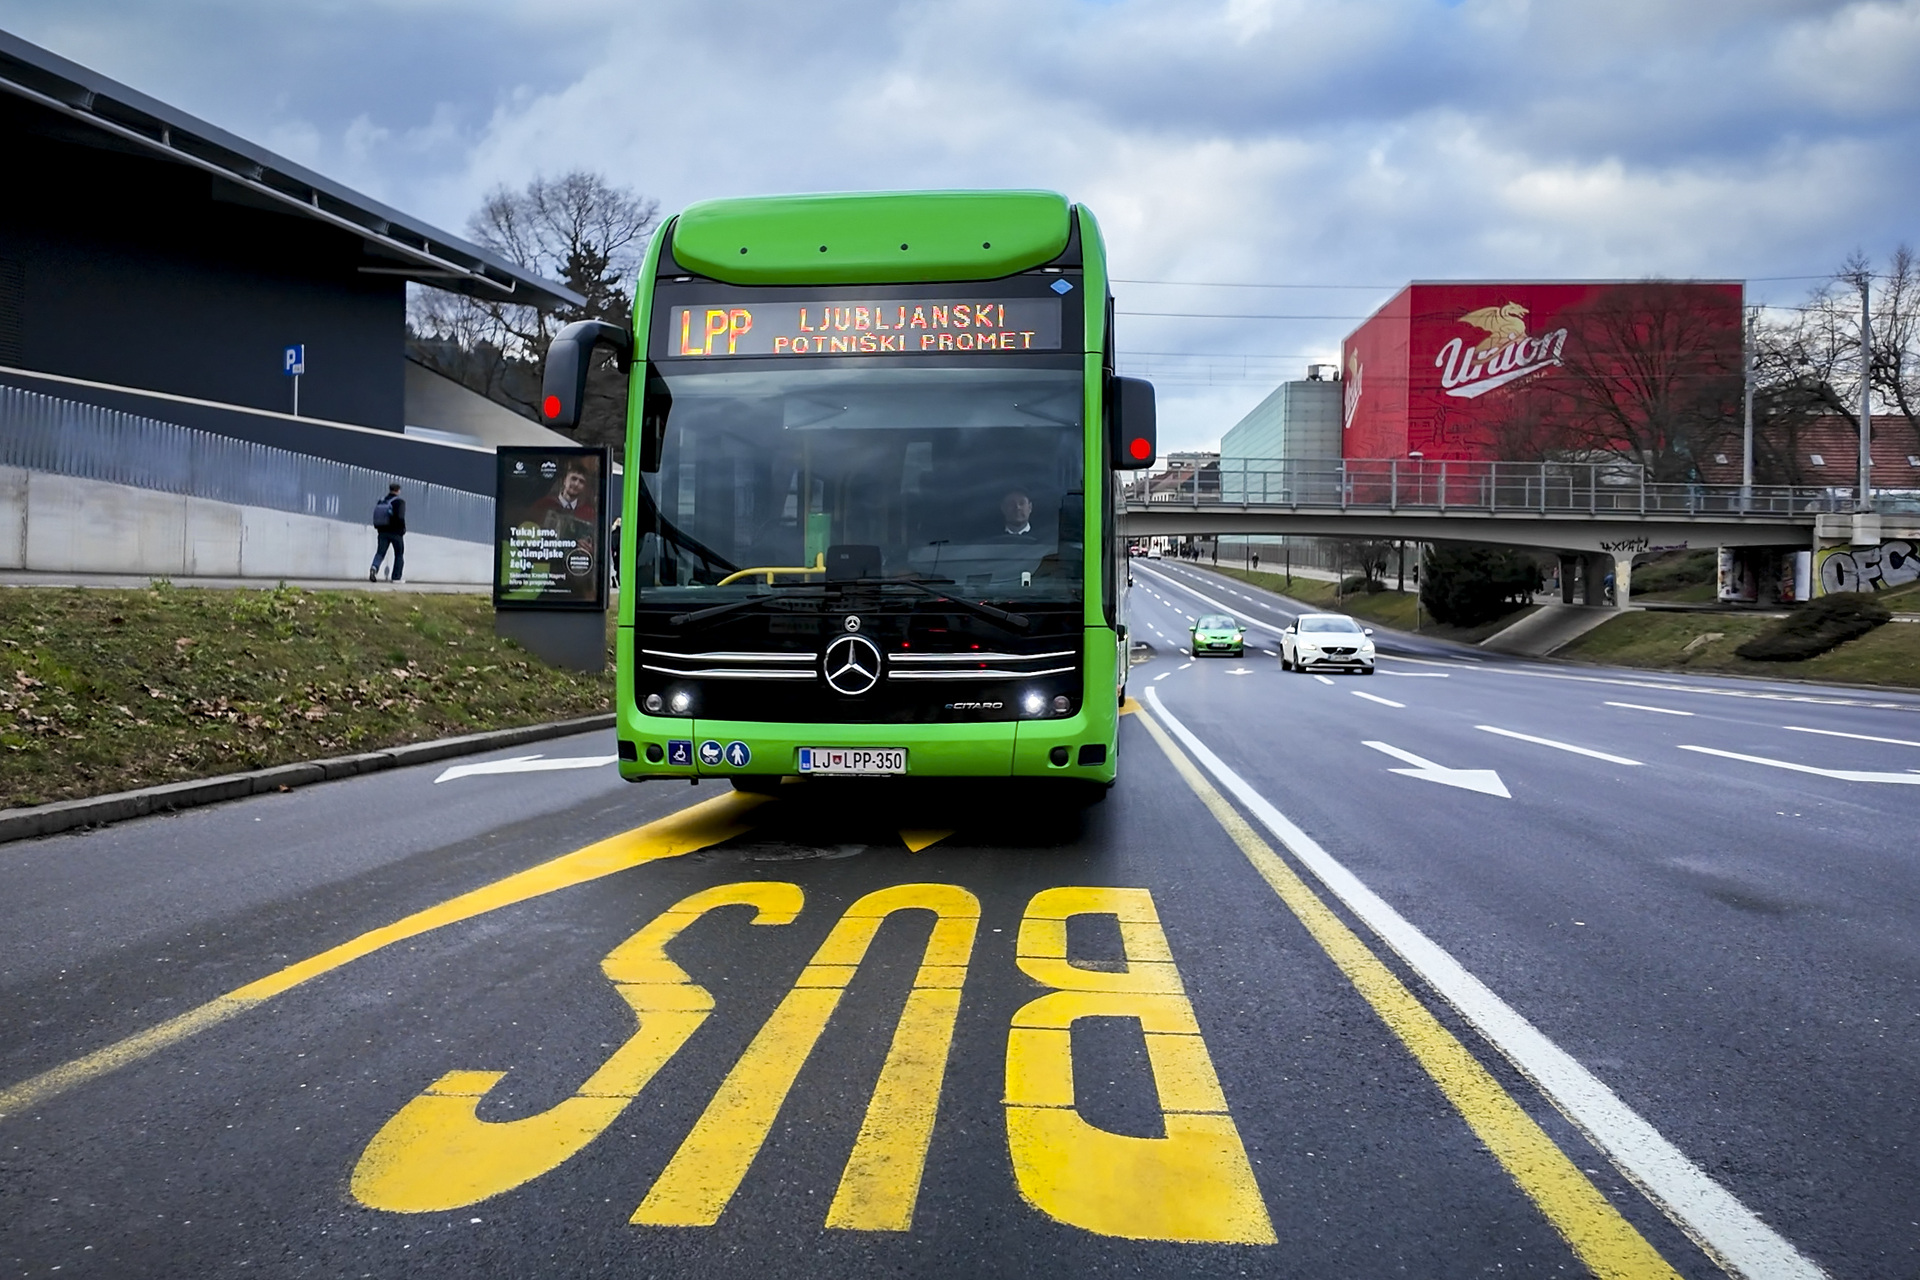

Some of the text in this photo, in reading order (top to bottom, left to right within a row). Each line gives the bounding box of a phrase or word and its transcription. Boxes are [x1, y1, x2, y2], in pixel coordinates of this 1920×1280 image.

[799, 303, 1006, 332] LJUBLJANSKI
[680, 308, 753, 356] LPP
[773, 331, 1036, 355] POTNIŠKI PROMET
[286, 349, 296, 370] P
[1435, 327, 1568, 390] Union
[510, 527, 558, 538] Tukaj smo,
[510, 538, 577, 549] ker verjamemo
[517, 548, 564, 560] olimpijske
[510, 558, 534, 570] želje.
[812, 752, 902, 769] LJ LPP-350
[349, 881, 1278, 1245] BUS
